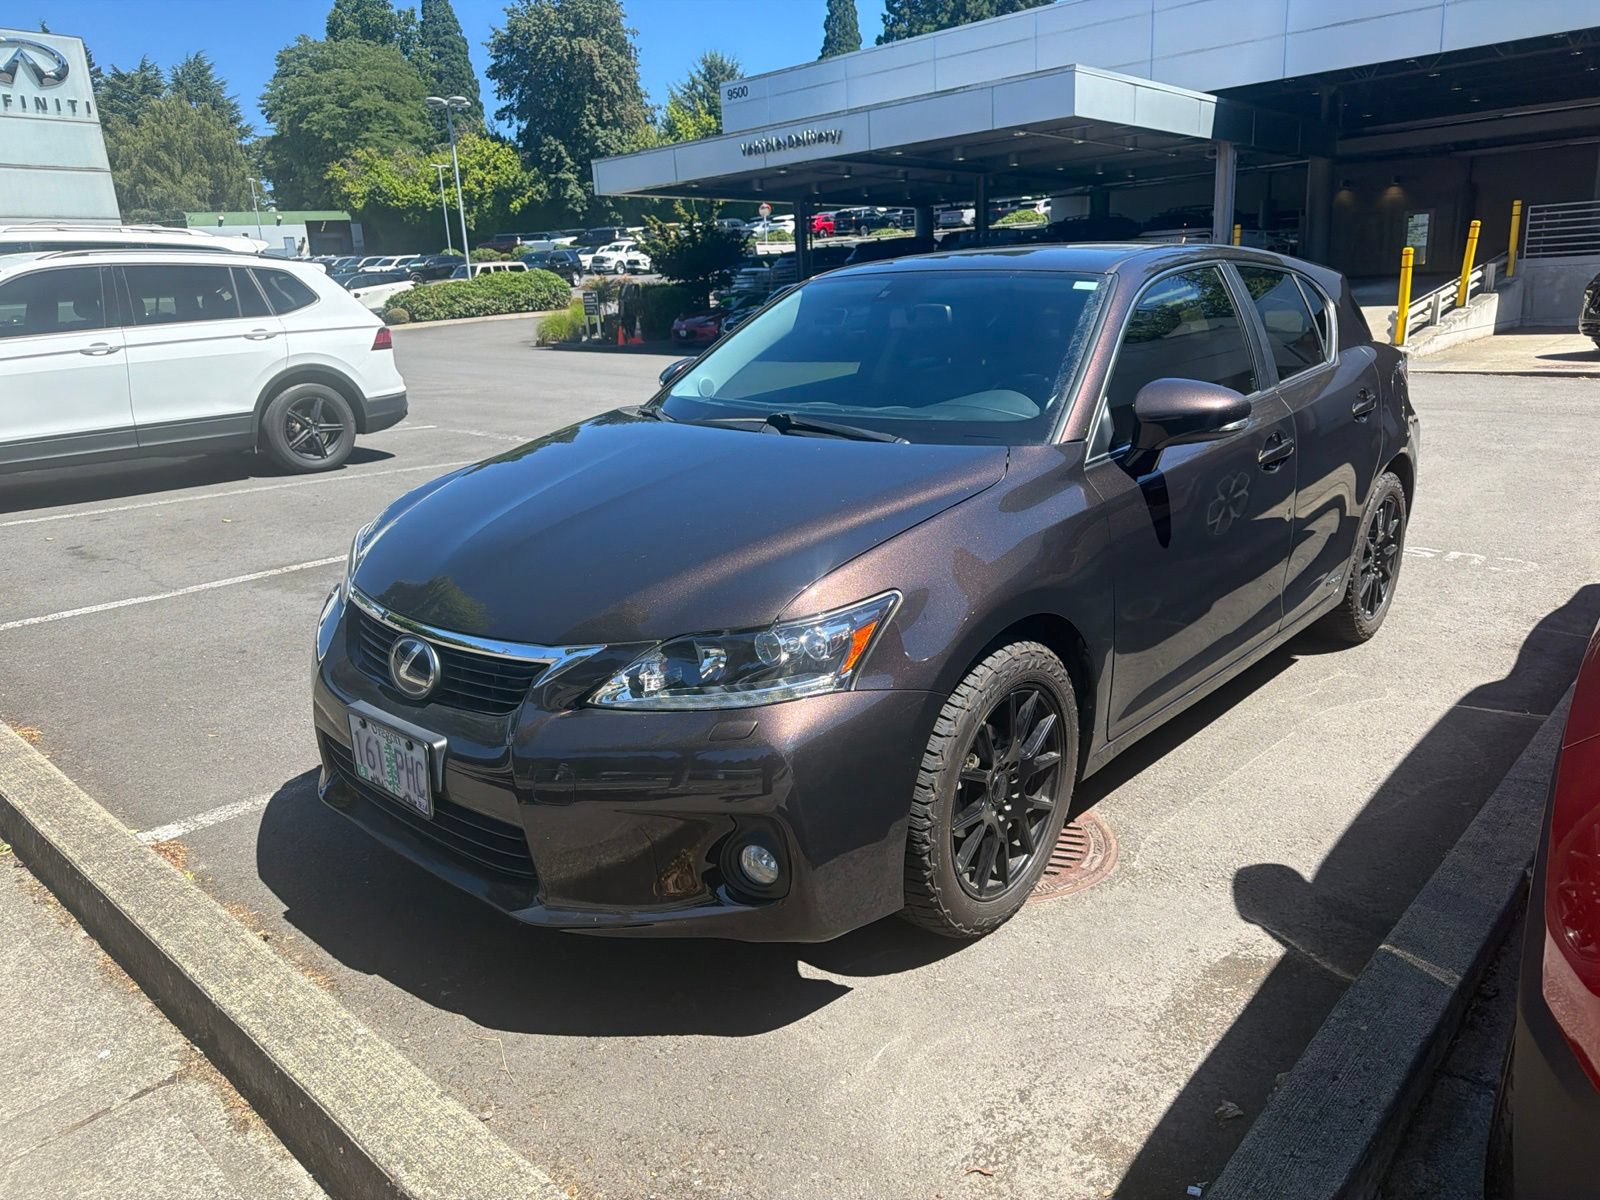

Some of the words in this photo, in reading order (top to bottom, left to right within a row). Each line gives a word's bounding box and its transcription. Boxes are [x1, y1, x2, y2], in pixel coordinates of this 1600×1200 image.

[2, 93, 91, 114] FINITI
[727, 85, 749, 100] 9500
[740, 136, 786, 156] Vehicle
[787, 128, 842, 149] Delivery
[354, 730, 385, 776] 161
